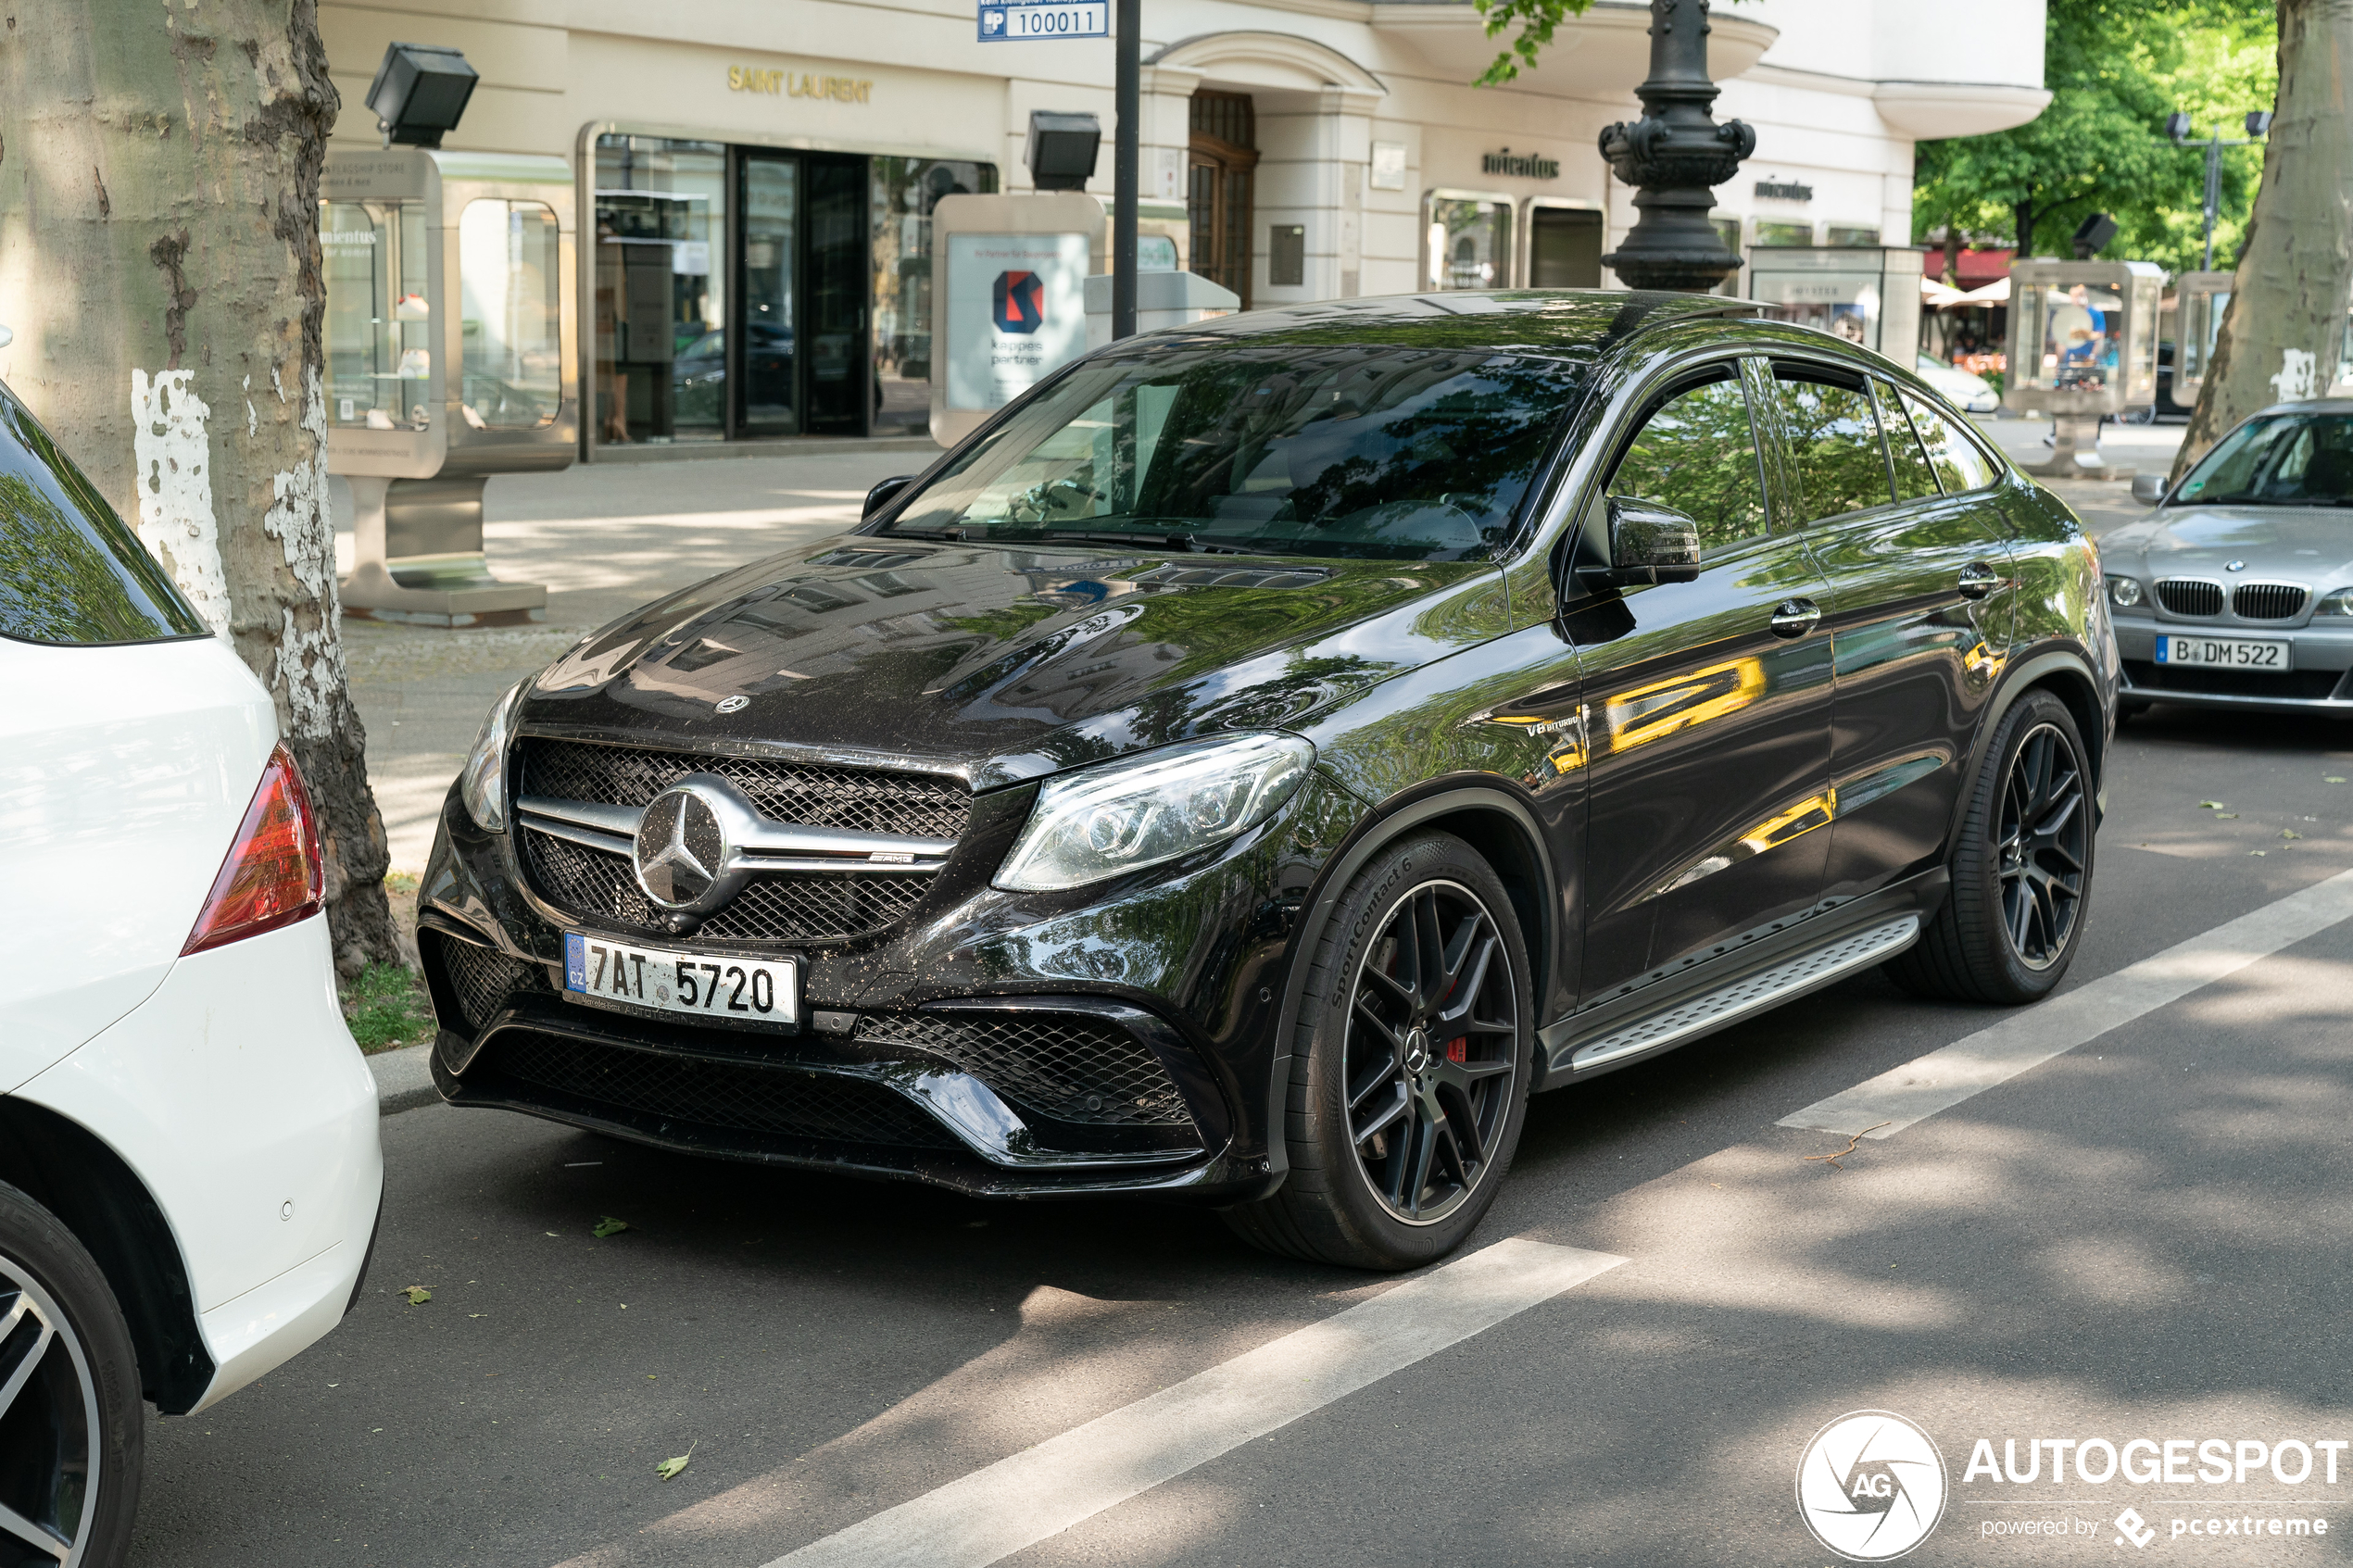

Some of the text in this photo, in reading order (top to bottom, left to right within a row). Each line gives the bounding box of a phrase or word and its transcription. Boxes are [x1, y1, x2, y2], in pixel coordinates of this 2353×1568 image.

[1020, 11, 1093, 33] 100011
[728, 66, 874, 104] SAINT LAURENT
[991, 339, 1043, 352] kappes
[991, 356, 1043, 368] partner
[2177, 641, 2279, 666] B DM 522
[1527, 716, 1579, 737] V8 BITURBO
[1331, 858, 1413, 1010] SportContact 6
[569, 971, 585, 986] CZ
[591, 945, 774, 1014] 7AT 5720
[582, 996, 621, 1012] Mercedes-Benz
